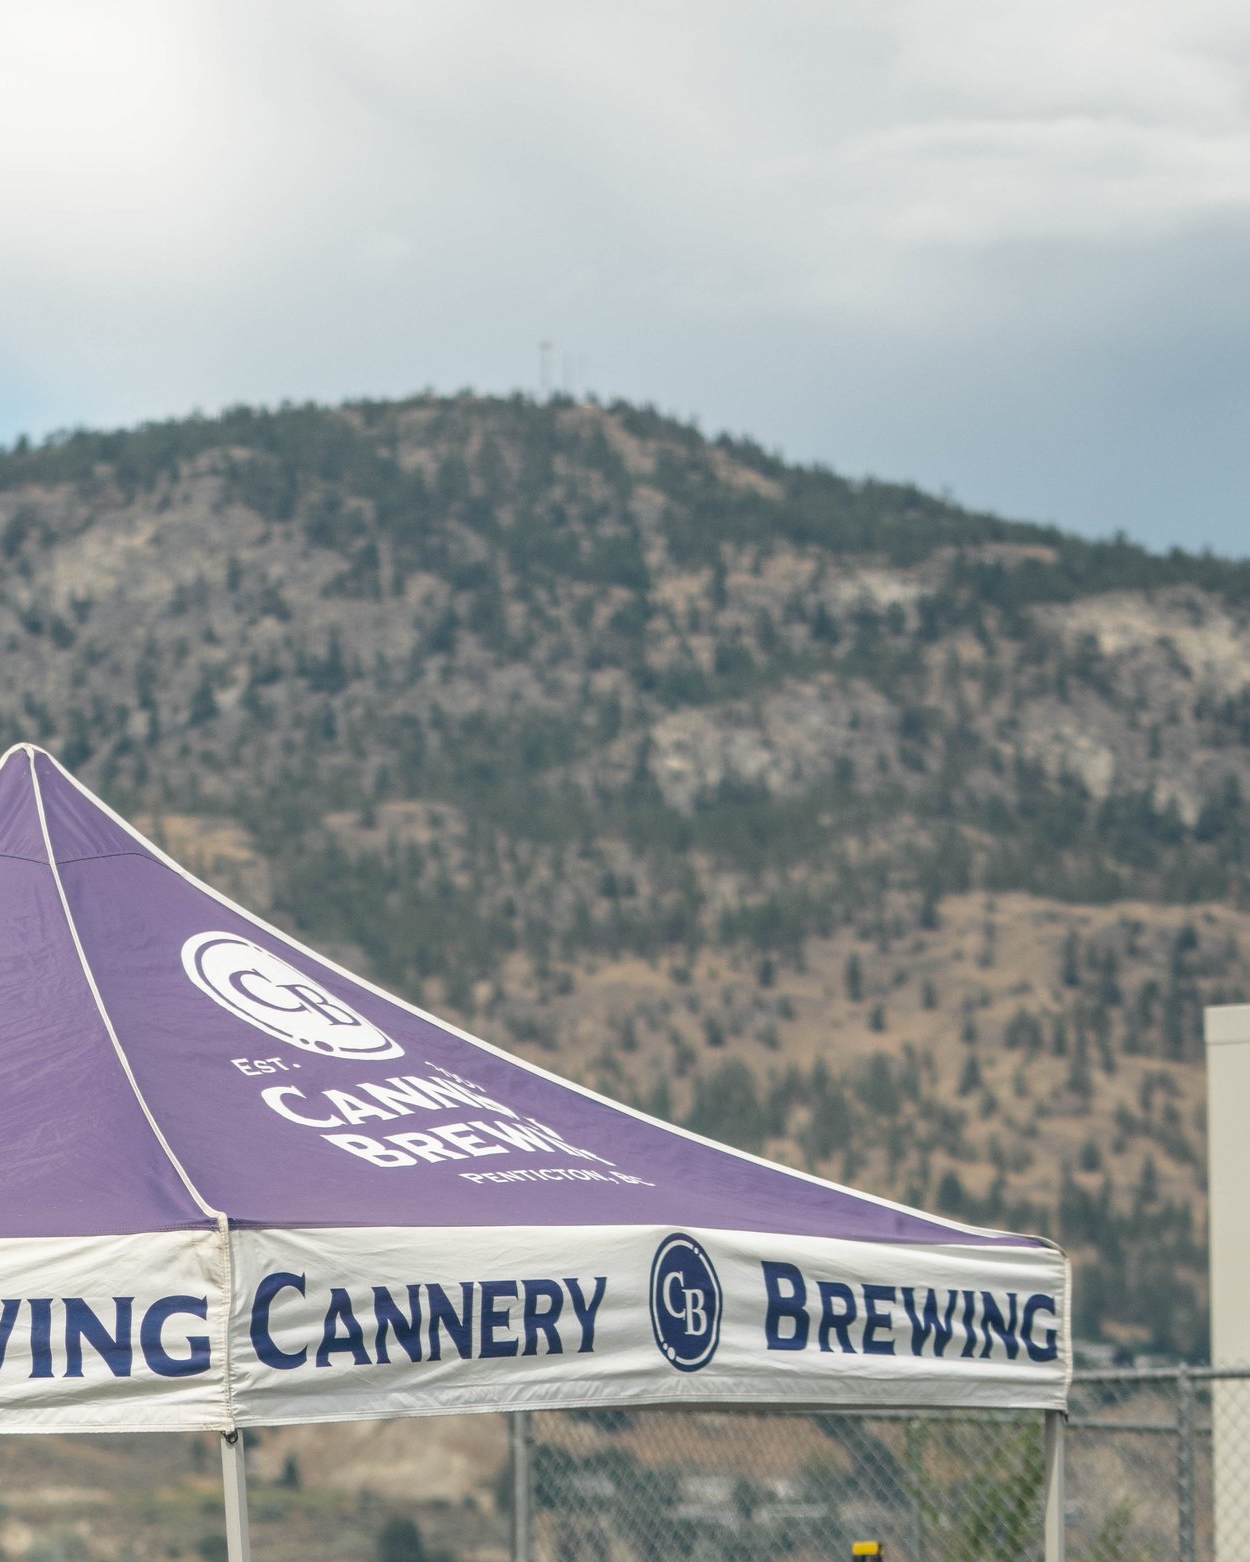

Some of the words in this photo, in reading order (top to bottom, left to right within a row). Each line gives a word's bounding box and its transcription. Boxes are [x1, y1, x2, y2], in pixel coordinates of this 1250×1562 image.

[249, 1271, 608, 1371] CANNERY
[662, 1271, 707, 1337] CB
[761, 1261, 1059, 1362] BREWING
